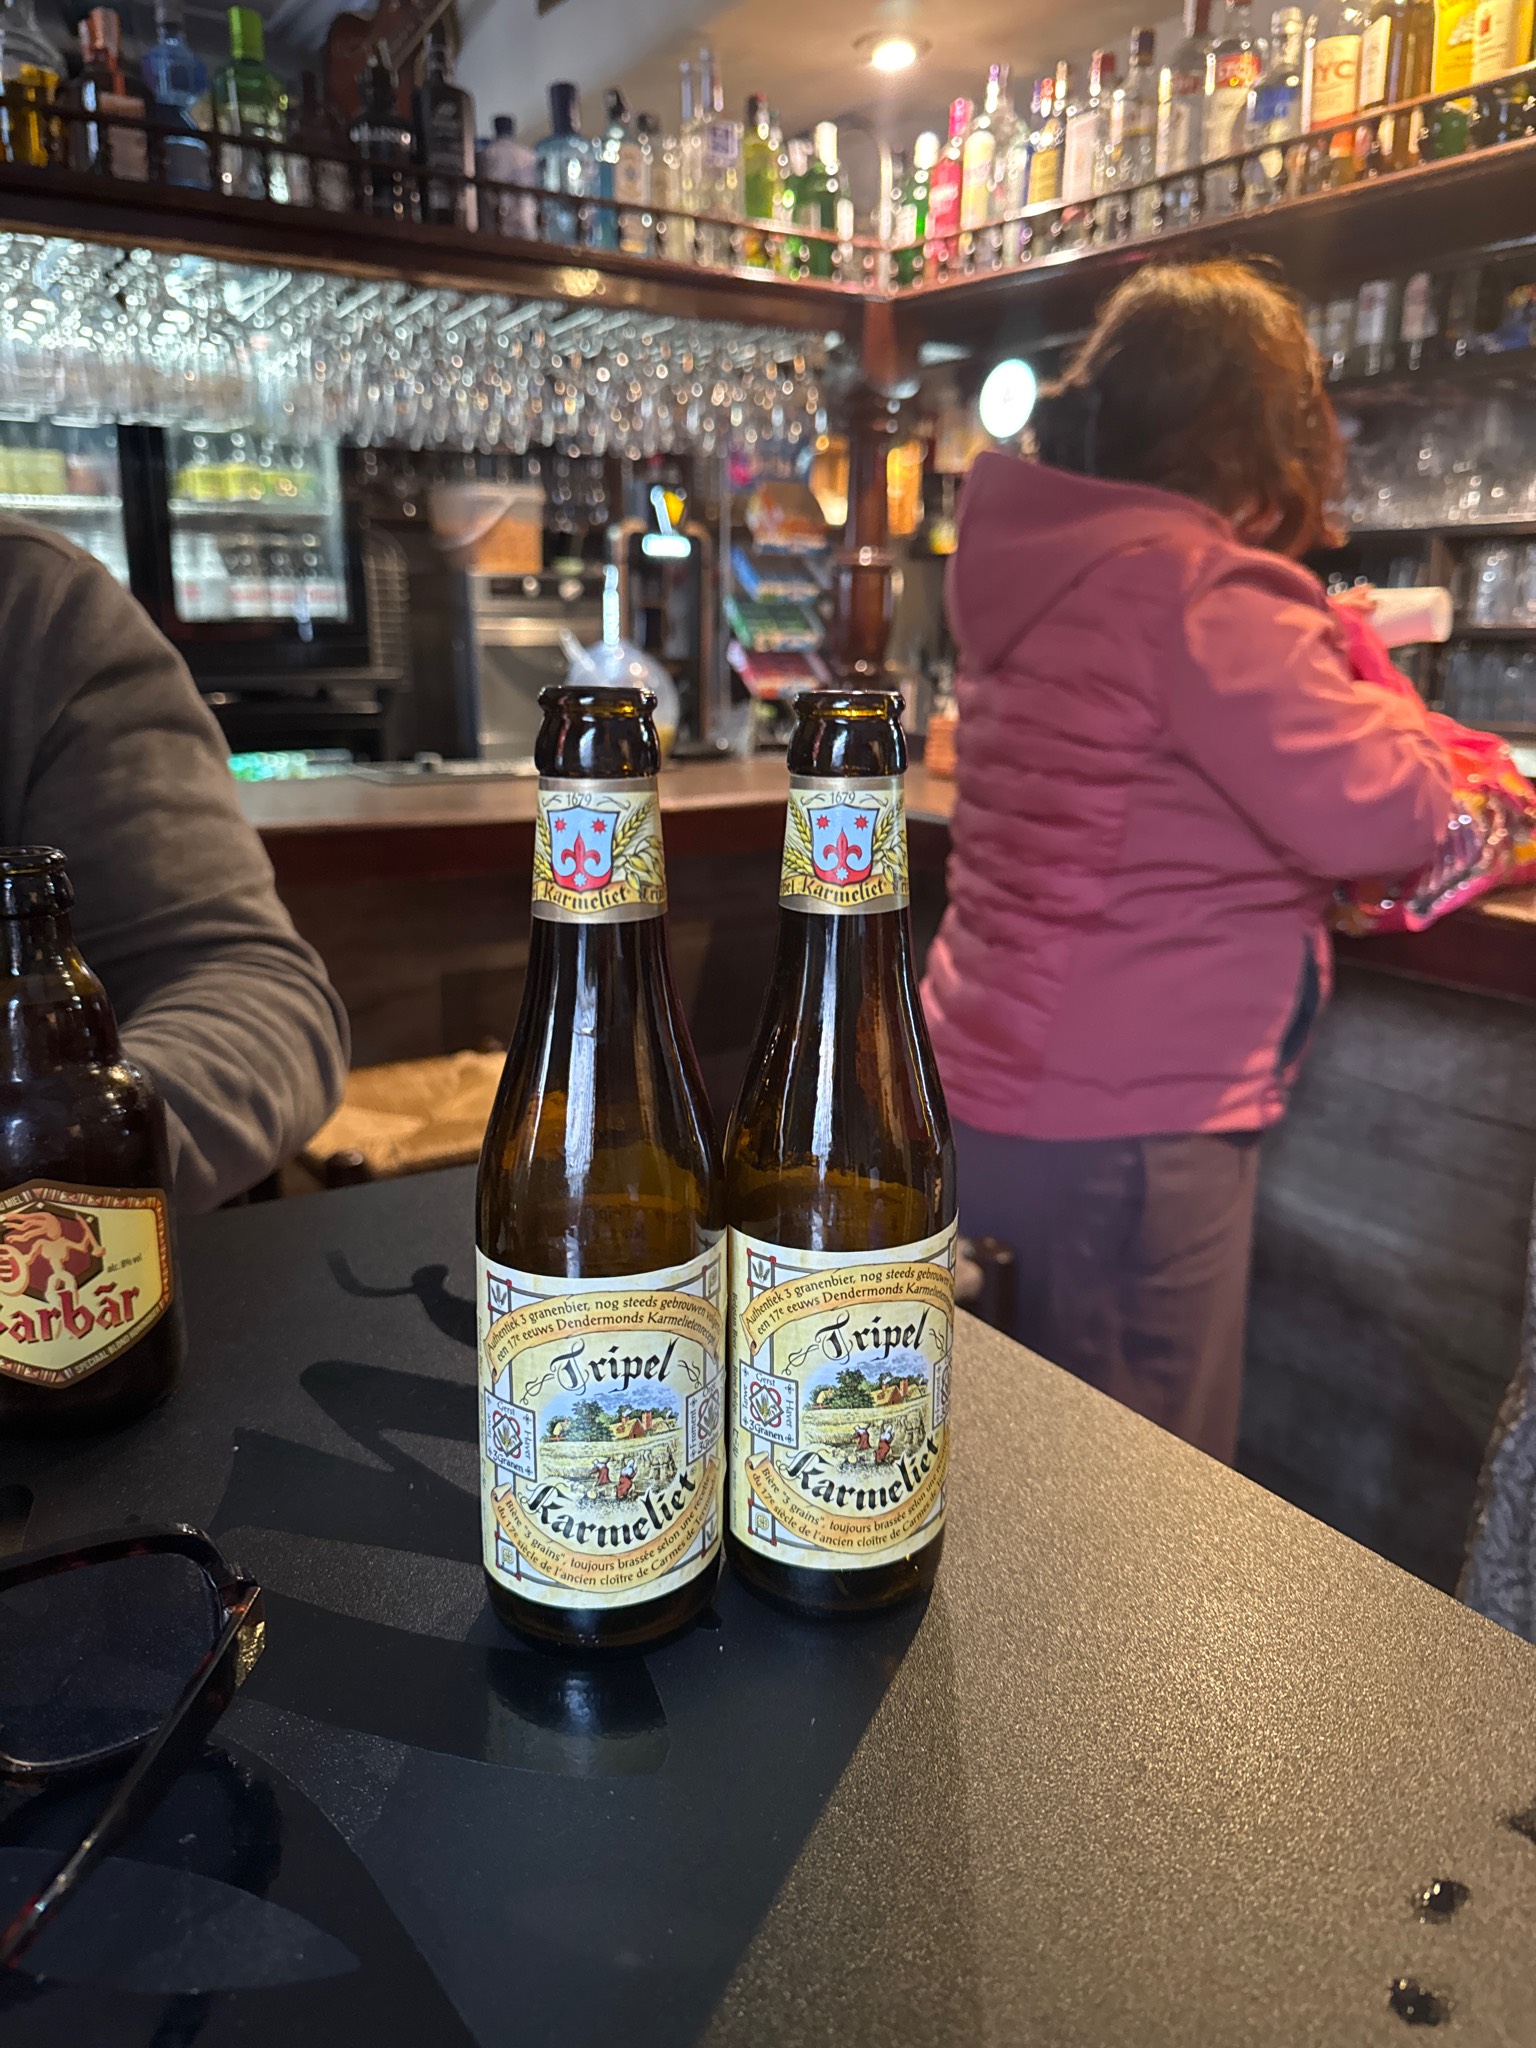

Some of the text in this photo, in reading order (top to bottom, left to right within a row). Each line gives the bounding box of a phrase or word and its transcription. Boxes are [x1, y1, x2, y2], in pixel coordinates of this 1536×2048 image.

[566, 793, 593, 806] 1679
[829, 792, 856, 804] 1679
[543, 881, 628, 911] Karmeliet
[801, 876, 884, 903] Karmeliet
[0, 1282, 140, 1344] arbãr
[488, 1317, 520, 1352] Authentiek
[519, 1313, 527, 1325] 3
[529, 1302, 591, 1325] granenbier,
[595, 1299, 619, 1312] nog
[623, 1295, 657, 1308] steeds
[660, 1297, 706, 1317] gebrouwen
[746, 1291, 784, 1326] Authentiek
[784, 1288, 792, 1299] 3
[794, 1275, 856, 1298] granenbier,
[860, 1272, 882, 1284] nog
[886, 1267, 915, 1280] steeds
[757, 1320, 770, 1336] een
[787, 1296, 820, 1314] eeuws
[822, 1283, 903, 1303] Dendermonds
[497, 1345, 509, 1362] een
[522, 1323, 554, 1342] eeuws
[556, 1312, 644, 1330] Dendermonds
[815, 1306, 931, 1365] Tripel
[550, 1337, 680, 1395] Tripel
[762, 1467, 779, 1493] Bière
[830, 1520, 871, 1534] toujours
[874, 1511, 906, 1531] brassée
[908, 1492, 926, 1513] selon
[926, 1475, 937, 1492] une
[776, 1437, 938, 1512] Karmeliet
[506, 1500, 521, 1526] Bière
[571, 1558, 614, 1571] toujours
[618, 1550, 654, 1569] brassée
[657, 1530, 680, 1552] selon
[680, 1511, 694, 1531] une
[517, 1471, 696, 1548] Karmeliet
[753, 1472, 762, 1487] du
[774, 1505, 797, 1529] siècle
[799, 1524, 811, 1537] de
[857, 1535, 887, 1547] cloître
[889, 1528, 900, 1540] de
[902, 1502, 930, 1533] Carmes
[497, 1505, 507, 1520] du
[517, 1540, 538, 1563] siècle
[540, 1561, 552, 1573] de
[600, 1573, 635, 1585] cloître
[636, 1565, 648, 1578] de
[651, 1540, 685, 1571] Carmes
[686, 1526, 695, 1541] de
